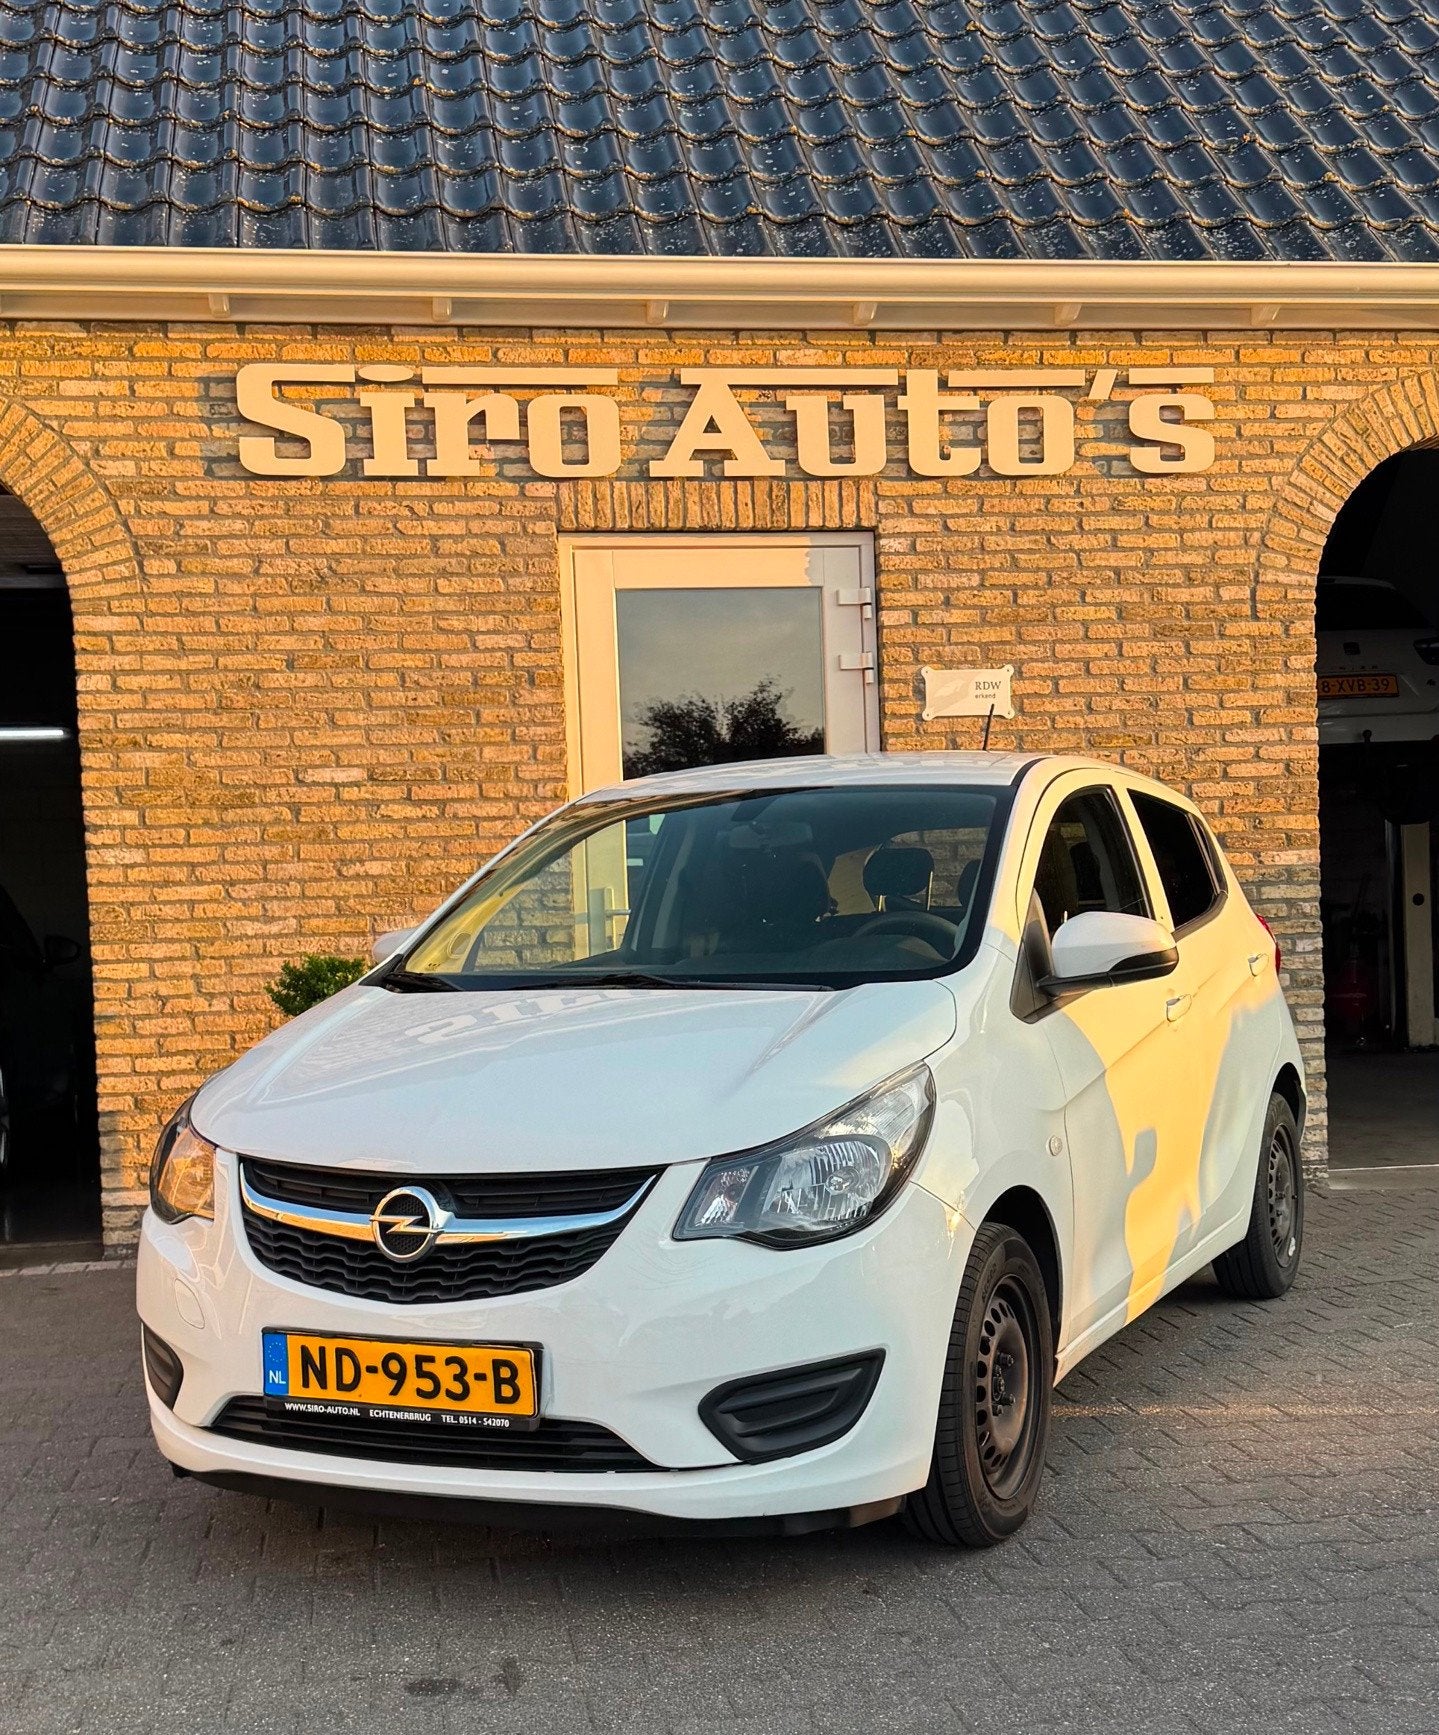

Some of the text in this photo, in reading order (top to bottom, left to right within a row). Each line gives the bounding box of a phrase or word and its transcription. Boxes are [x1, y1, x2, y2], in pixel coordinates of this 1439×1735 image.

[236, 363, 1216, 478] Siro Auto's
[975, 681, 1001, 690] RDW
[268, 1369, 287, 1384] NL
[300, 1344, 521, 1404] ND-953-B
[284, 1402, 361, 1416] WWW.SIRO-AUTO.NL
[369, 1409, 432, 1422] ECHTENERBRUG
[458, 1416, 477, 1425] 0514
[483, 1417, 510, 1428] 542070
